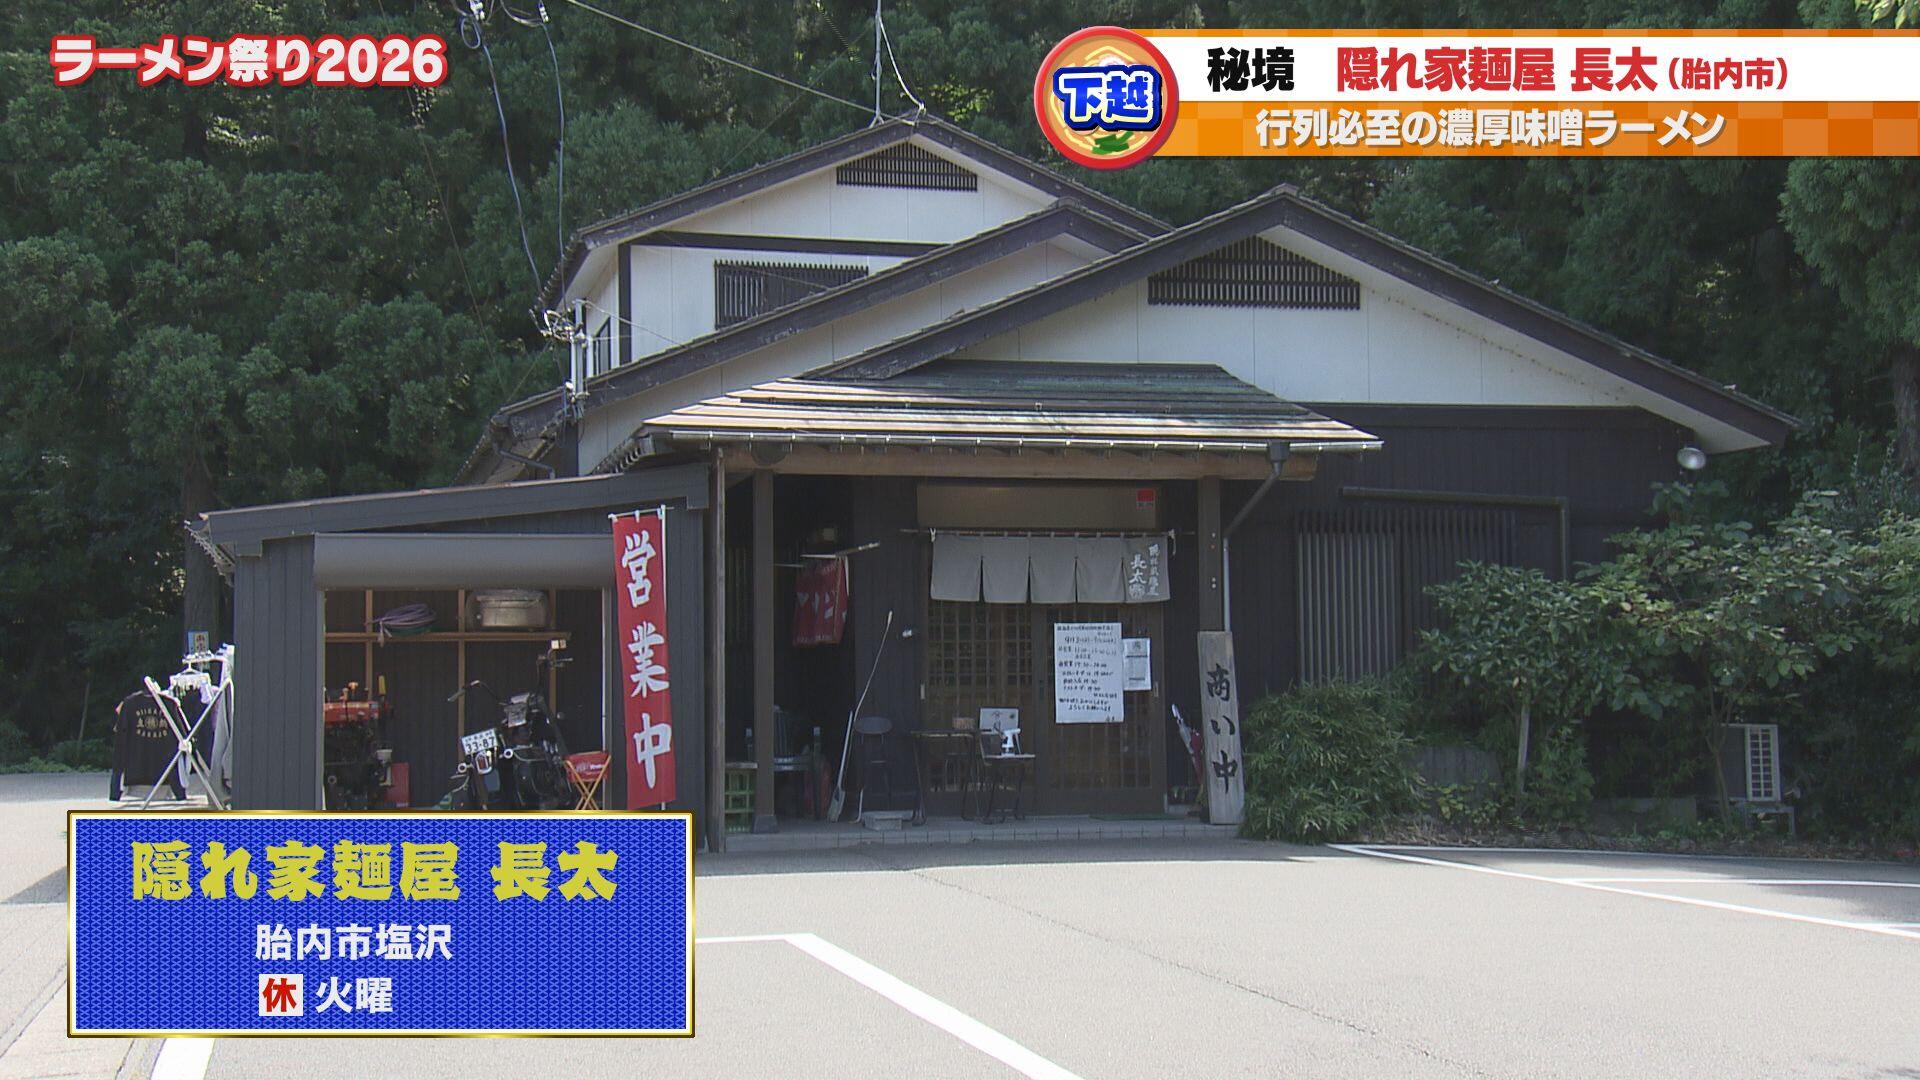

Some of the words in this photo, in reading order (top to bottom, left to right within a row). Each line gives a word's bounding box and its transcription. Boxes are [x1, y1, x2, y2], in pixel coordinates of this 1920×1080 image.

[621, 529, 673, 790] 営業中
[1206, 663, 1238, 795] 商い中
